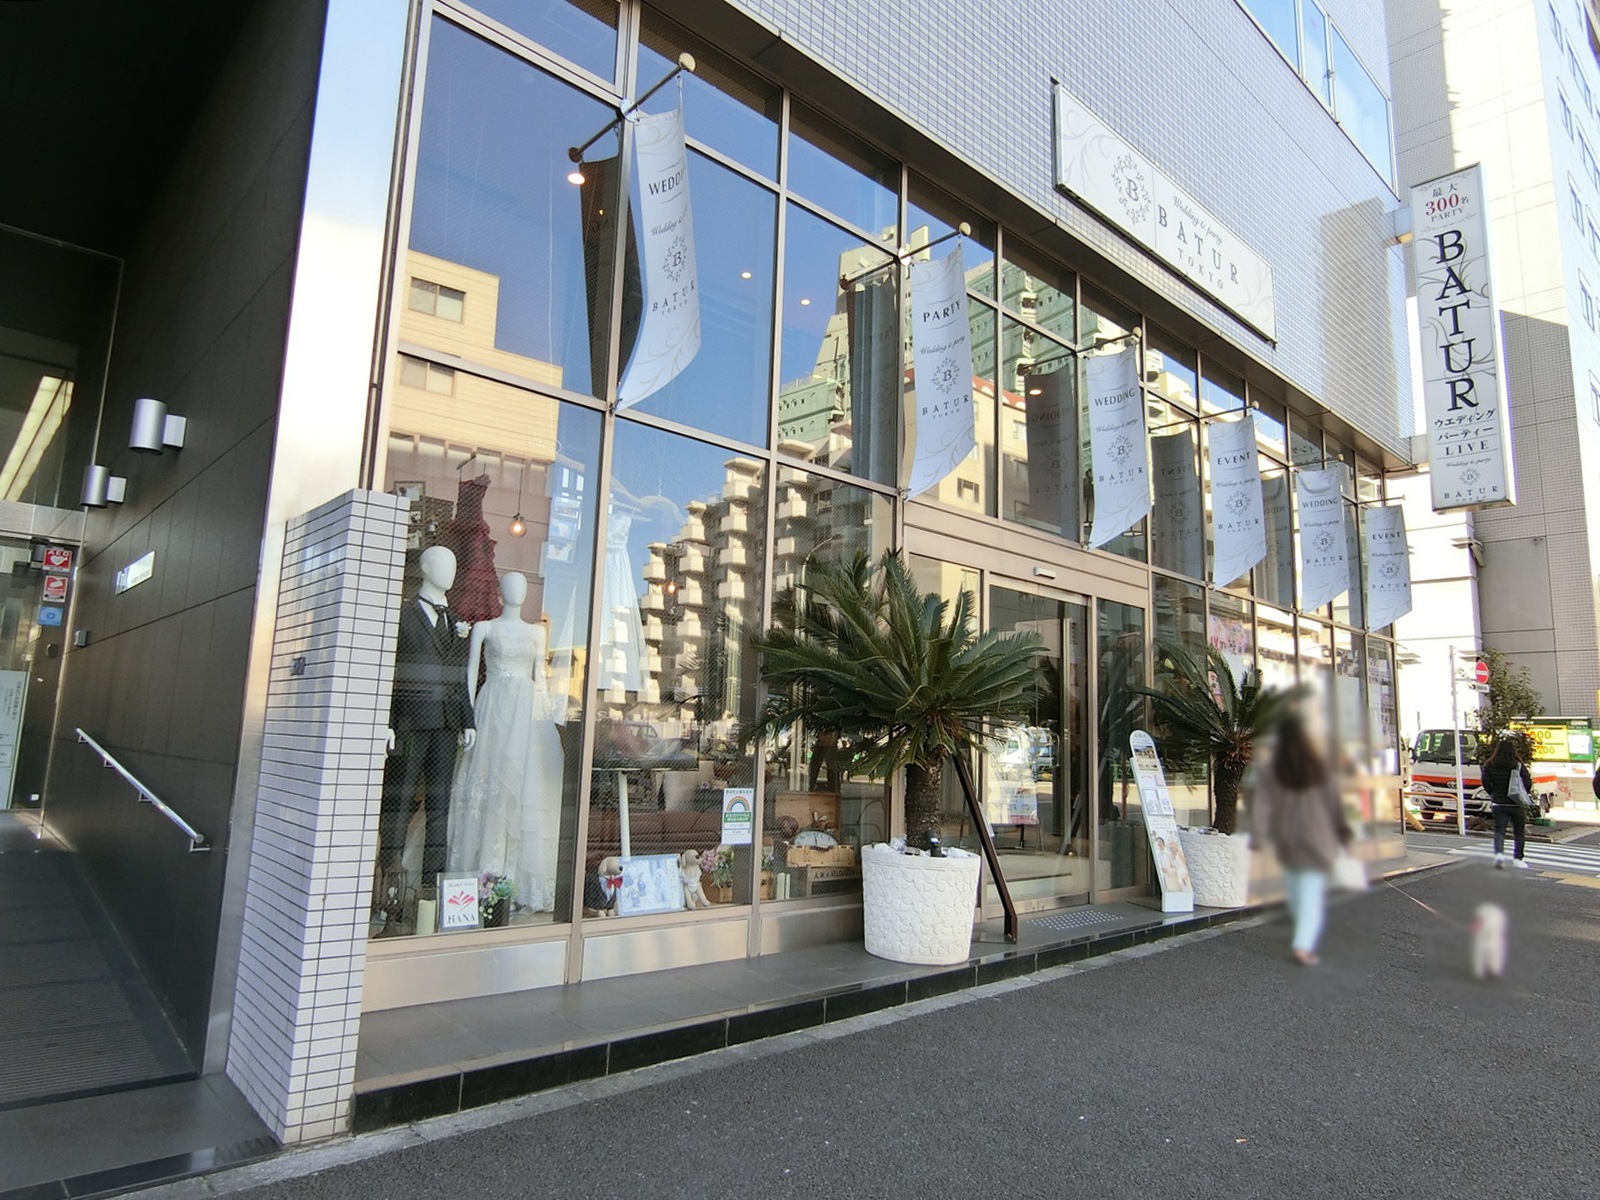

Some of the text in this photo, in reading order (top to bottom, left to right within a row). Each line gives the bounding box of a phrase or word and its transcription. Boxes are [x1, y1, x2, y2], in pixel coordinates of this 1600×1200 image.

[1123, 173, 1139, 201] B
[1432, 183, 1458, 198] 最大
[1173, 196, 1200, 227] Wedding
[1206, 227, 1222, 246] party
[1431, 207, 1464, 222] PARTY
[1158, 204, 1239, 285] BATUR
[673, 252, 681, 267] B
[1178, 247, 1223, 290] TOKYO
[652, 280, 695, 312] BATUR
[923, 299, 961, 322] PARTY
[1434, 229, 1479, 411] BATUR
[920, 344, 947, 354] Wedding
[943, 370, 952, 382] B
[922, 395, 969, 415] BATUR
[1094, 388, 1136, 407] WEDDING
[1434, 408, 1496, 428] ウエディング
[1117, 445, 1126, 456] B
[1445, 440, 1489, 456] LIVE
[1217, 451, 1251, 465] EVENT
[1099, 466, 1143, 482] BATUR
[1444, 486, 1498, 499] BATUR
[1235, 499, 1243, 508] B
[1302, 497, 1339, 508] WEDDING
[1218, 518, 1259, 530] BATUR
[1372, 531, 1401, 541] EVENT
[447, 913, 476, 925] HANA
